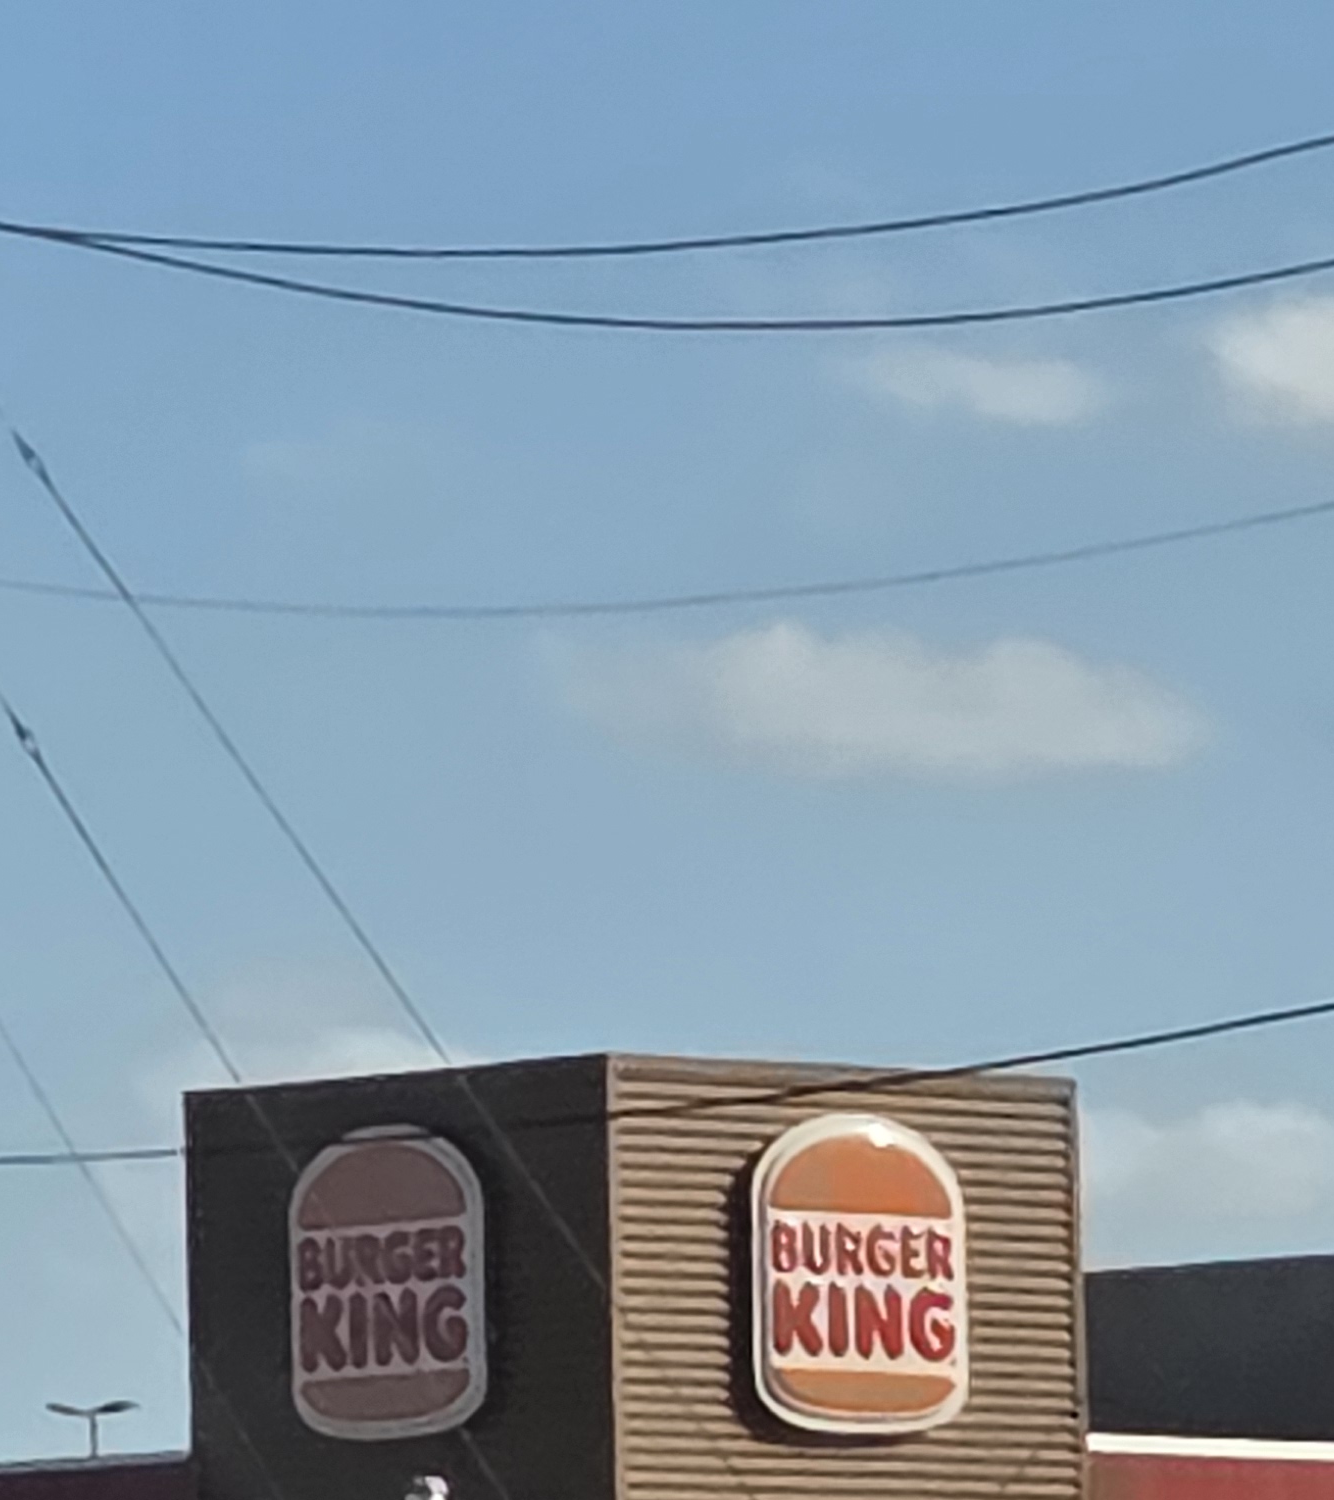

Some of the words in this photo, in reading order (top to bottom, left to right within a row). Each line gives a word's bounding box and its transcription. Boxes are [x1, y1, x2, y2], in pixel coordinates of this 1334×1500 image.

[297, 1225, 467, 1292] BURGER
[770, 1218, 955, 1282] BURGER
[298, 1284, 470, 1373] KING
[771, 1280, 957, 1362] KING
